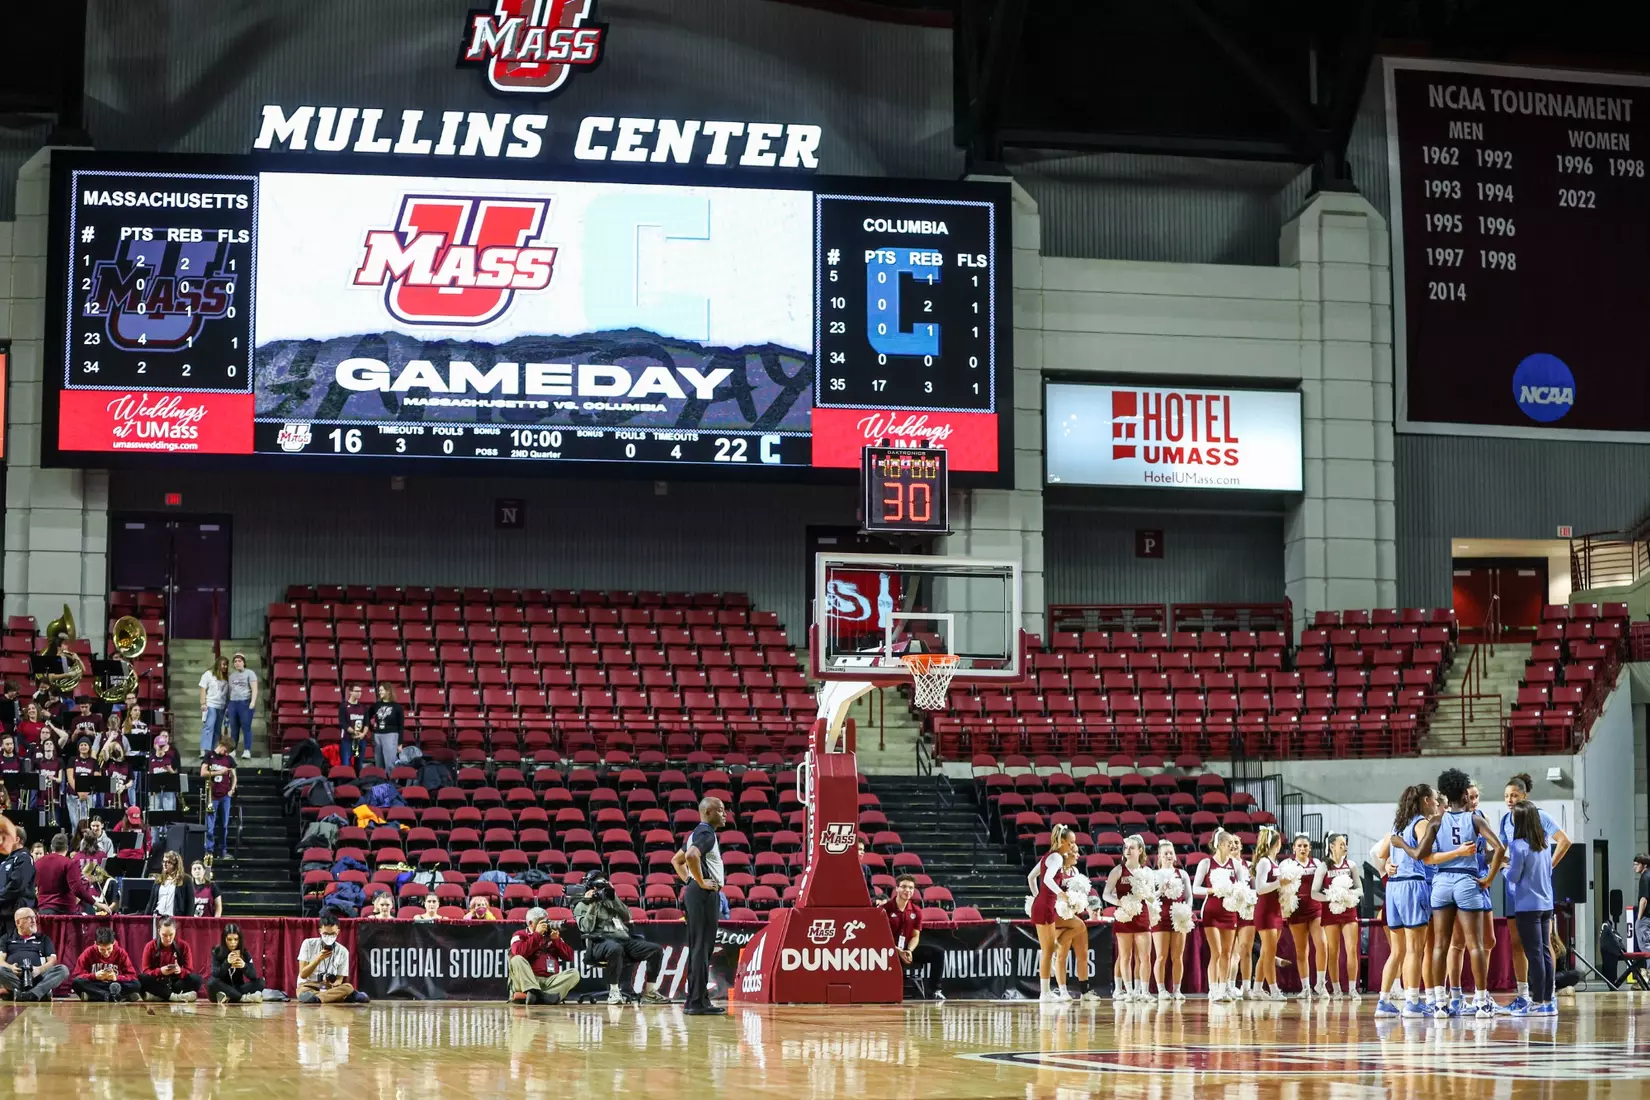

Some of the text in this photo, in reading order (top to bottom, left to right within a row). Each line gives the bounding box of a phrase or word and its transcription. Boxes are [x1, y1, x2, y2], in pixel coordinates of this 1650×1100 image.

[1428, 84, 1633, 122] NCAA TOURNAMENT
[254, 105, 823, 169] MULLINS CENTER
[1449, 121, 1484, 141] MEN
[1568, 129, 1630, 151] WOMEN
[1422, 145, 1513, 169] 1962 1992
[1556, 155, 1646, 178] 1996 1998
[83, 190, 248, 209] MASSACHUSETTS
[1424, 179, 1514, 203] 1993 1994
[1558, 188, 1596, 209] 2022
[82, 226, 250, 243] # PTS REB FLS
[863, 218, 949, 235] COLUMBIA
[1425, 213, 1515, 237] 1995 1996
[83, 255, 236, 271] 1 2 2 1
[827, 248, 988, 268] # PTS REB FLS
[1426, 248, 1517, 271] 1997 1998
[82, 278, 235, 294] 2 0 0 0
[829, 270, 978, 287] 5 0 1 1
[1429, 281, 1467, 301] 2014
[84, 302, 236, 318] 12 0 1 0
[830, 297, 979, 314] 10 0 2 1
[829, 322, 979, 338] 23 0 1 1
[83, 333, 238, 349] 23 4 1 1
[83, 361, 236, 377] 34 2 2 0
[829, 352, 978, 368] 34 0 0 0
[335, 358, 734, 399] GAMEDAY
[829, 378, 979, 395] 35 17 3 1
[403, 397, 668, 412] MASSACHUSETTS VS. COLUMBIA
[1519, 385, 1574, 405] NCAA
[107, 393, 208, 427] Weddings
[1142, 392, 1239, 444] HOTEL
[112, 419, 198, 439] at UMass
[378, 426, 424, 435] TIMEOUTS
[433, 427, 464, 436] FOULS
[577, 430, 699, 441] BONUS FOULS TIMEOUTS
[857, 412, 953, 443] Weddings
[113, 441, 198, 452] umassweddings.com
[329, 429, 362, 453] 16
[396, 438, 453, 454] 3 0
[510, 430, 562, 447] 10:00
[475, 448, 498, 457] POSS
[511, 450, 561, 459] 2ND Quarter
[625, 443, 682, 459] 0 4
[714, 438, 747, 462] 22
[1143, 445, 1239, 466] UMASS
[1144, 471, 1240, 485] HotelUMass.com
[883, 482, 931, 522] 30
[501, 508, 518, 523] N
[1144, 538, 1156, 553] P
[1452, 827, 1461, 845] 5
[370, 947, 444, 978] OFFICIAL
[781, 946, 895, 971] DUNKIN'
[942, 947, 1013, 979] MULLINS
